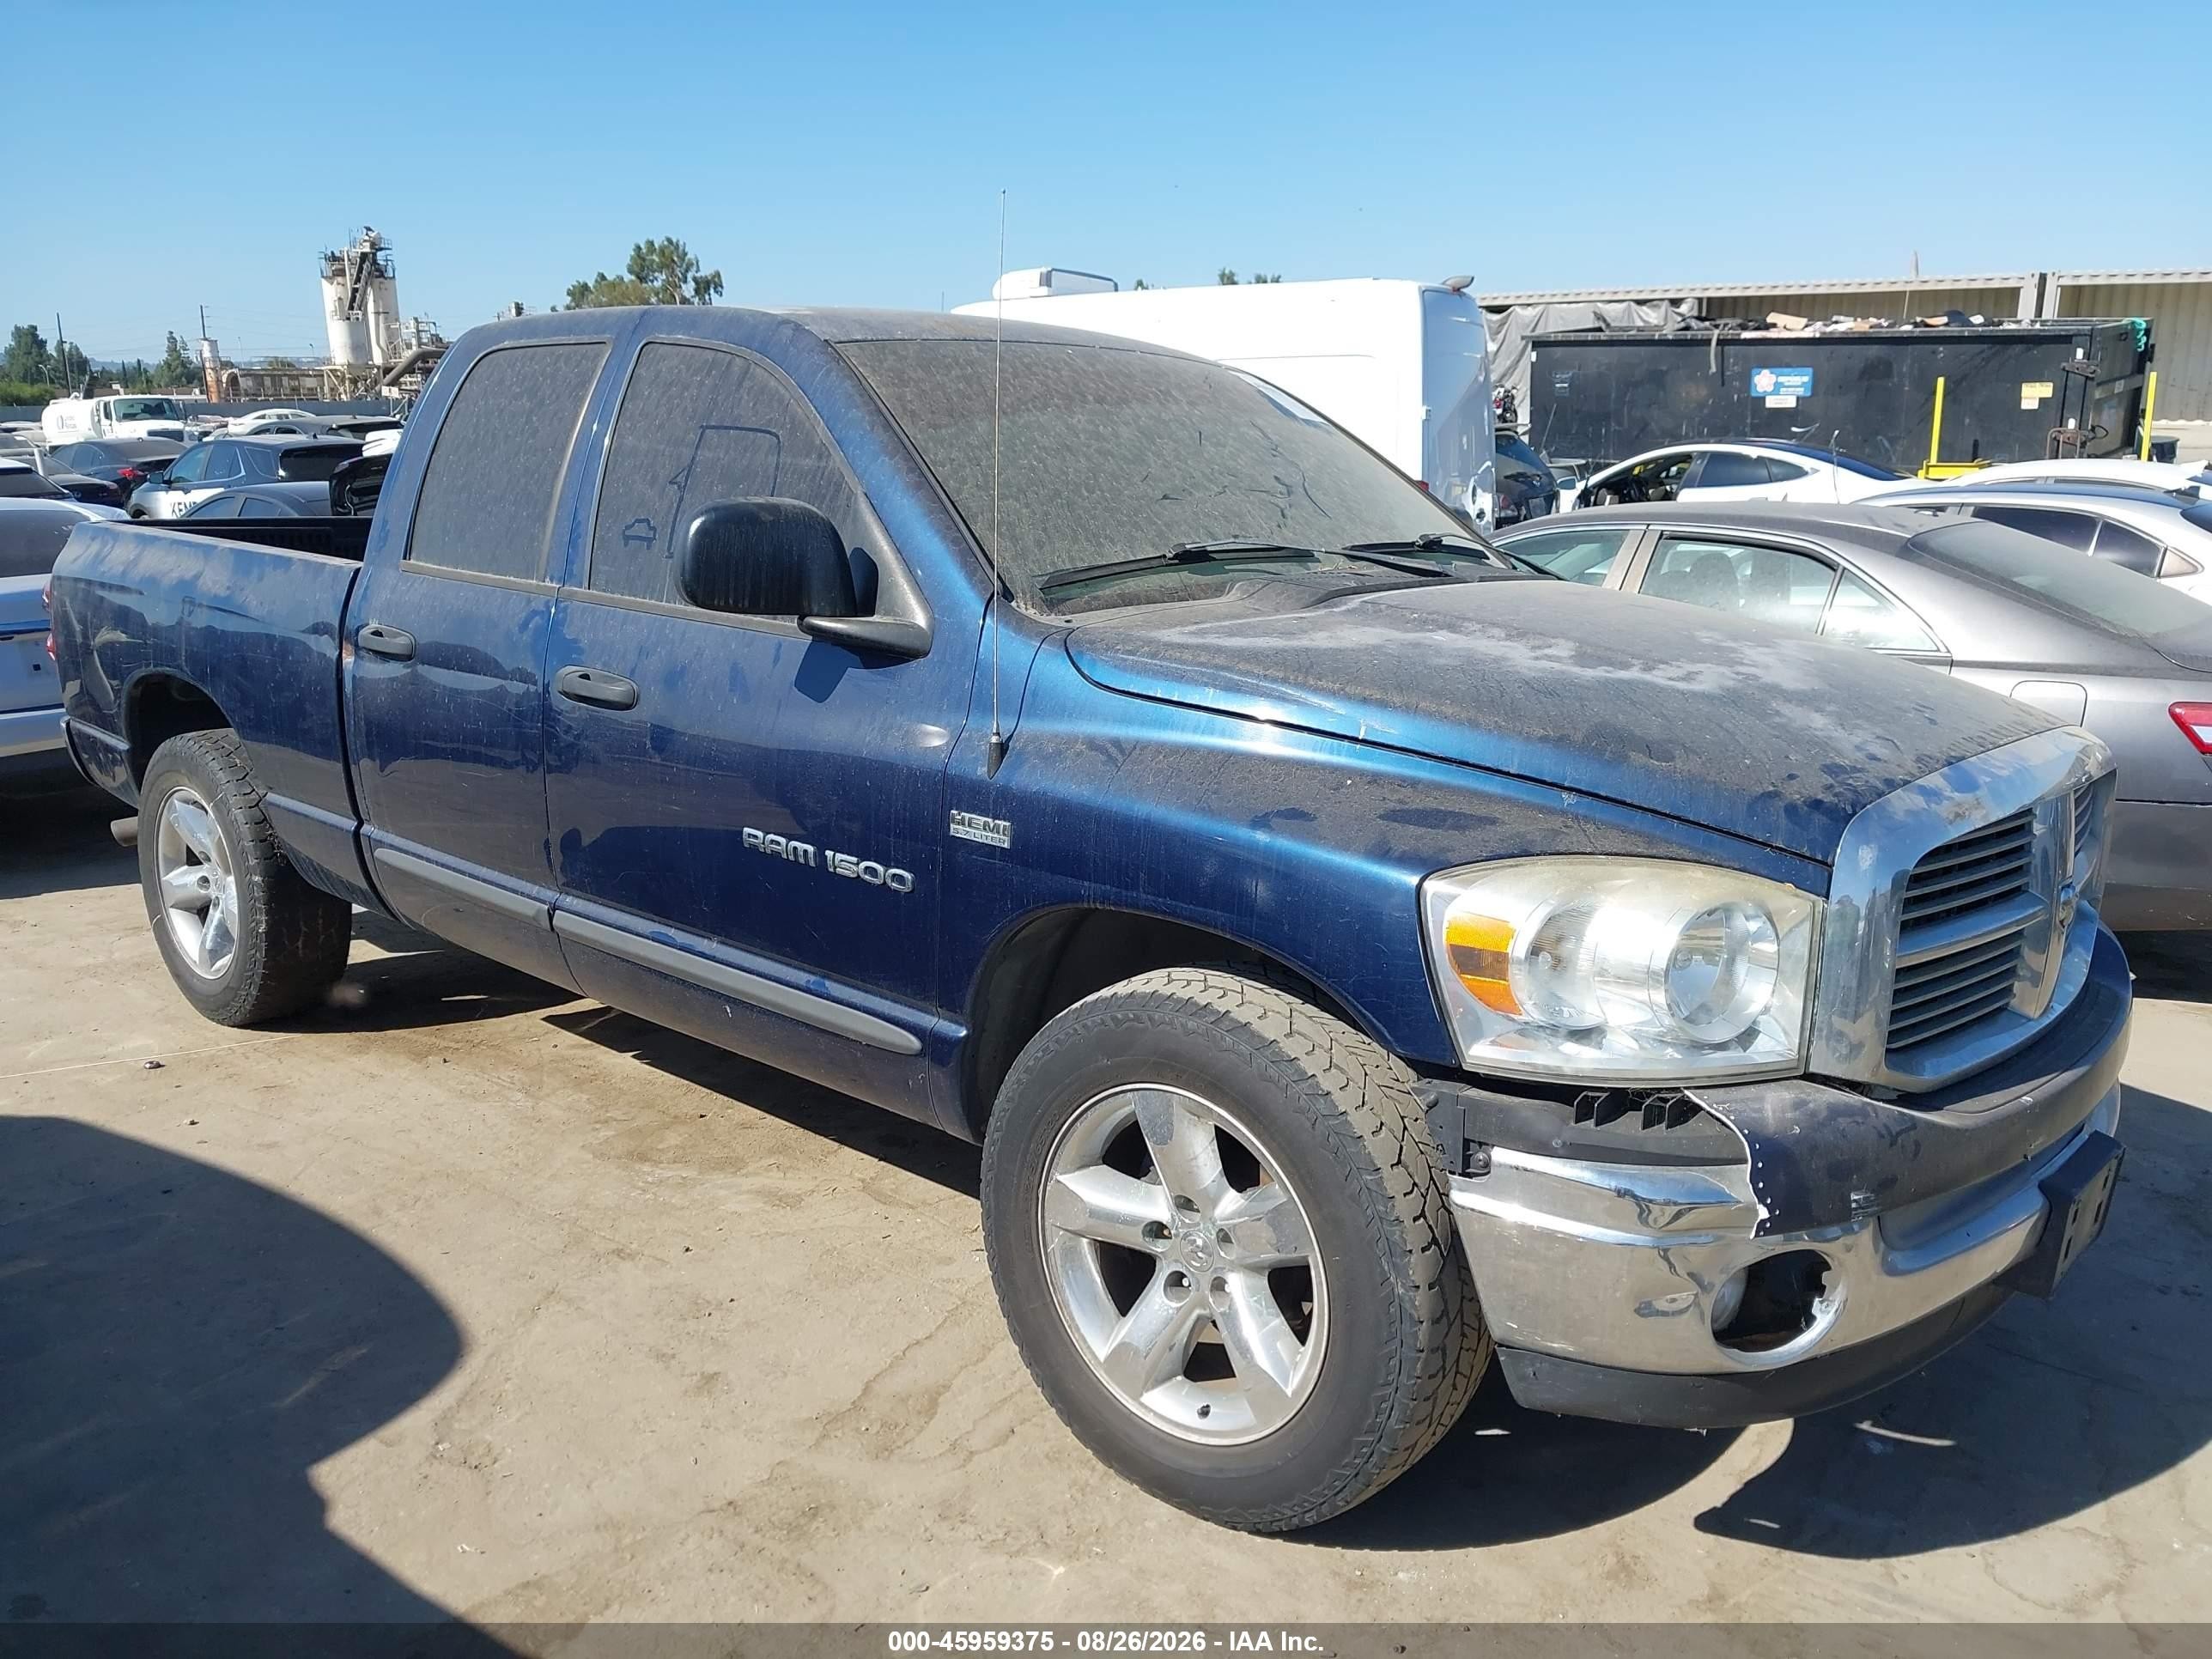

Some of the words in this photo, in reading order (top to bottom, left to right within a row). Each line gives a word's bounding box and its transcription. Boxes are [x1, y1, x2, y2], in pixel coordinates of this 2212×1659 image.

[950, 811, 1011, 837] HEMI
[952, 827, 970, 836] 5.7
[973, 831, 1006, 846] LITER
[742, 826, 818, 867] RAM
[824, 849, 915, 894] 1500
